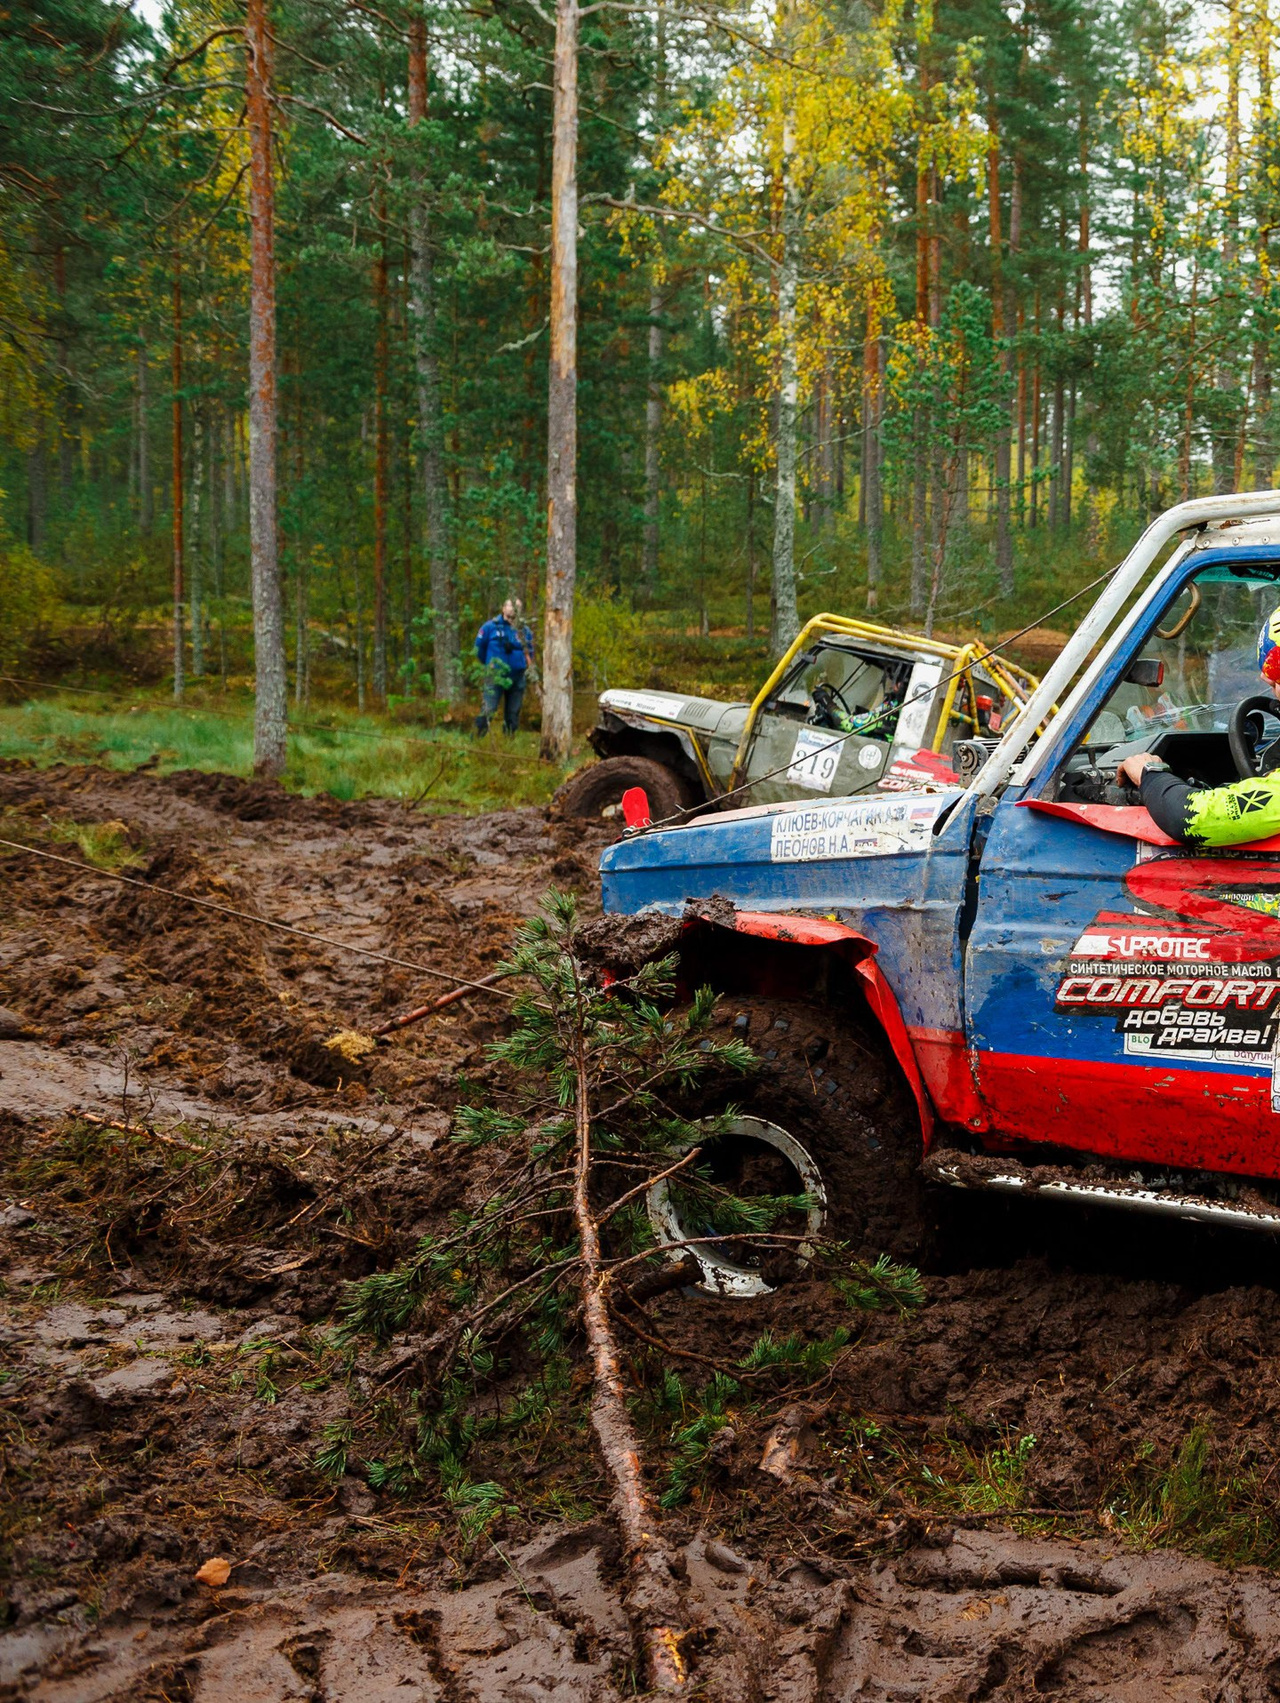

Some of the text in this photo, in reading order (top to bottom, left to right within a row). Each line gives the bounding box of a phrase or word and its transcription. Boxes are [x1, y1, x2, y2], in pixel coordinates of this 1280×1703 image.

[793, 749, 835, 779] 219
[775, 834, 851, 858] ЛЕОНОВ Н.А.
[1104, 934, 1210, 959] SUPROTEC
[1070, 963, 1272, 977] СИНТЕТИЧЕСКОЕ МОТОРНОЕ МАСЛО
[1123, 1005, 1226, 1028] добавь
[1157, 1024, 1272, 1046] драйва!
